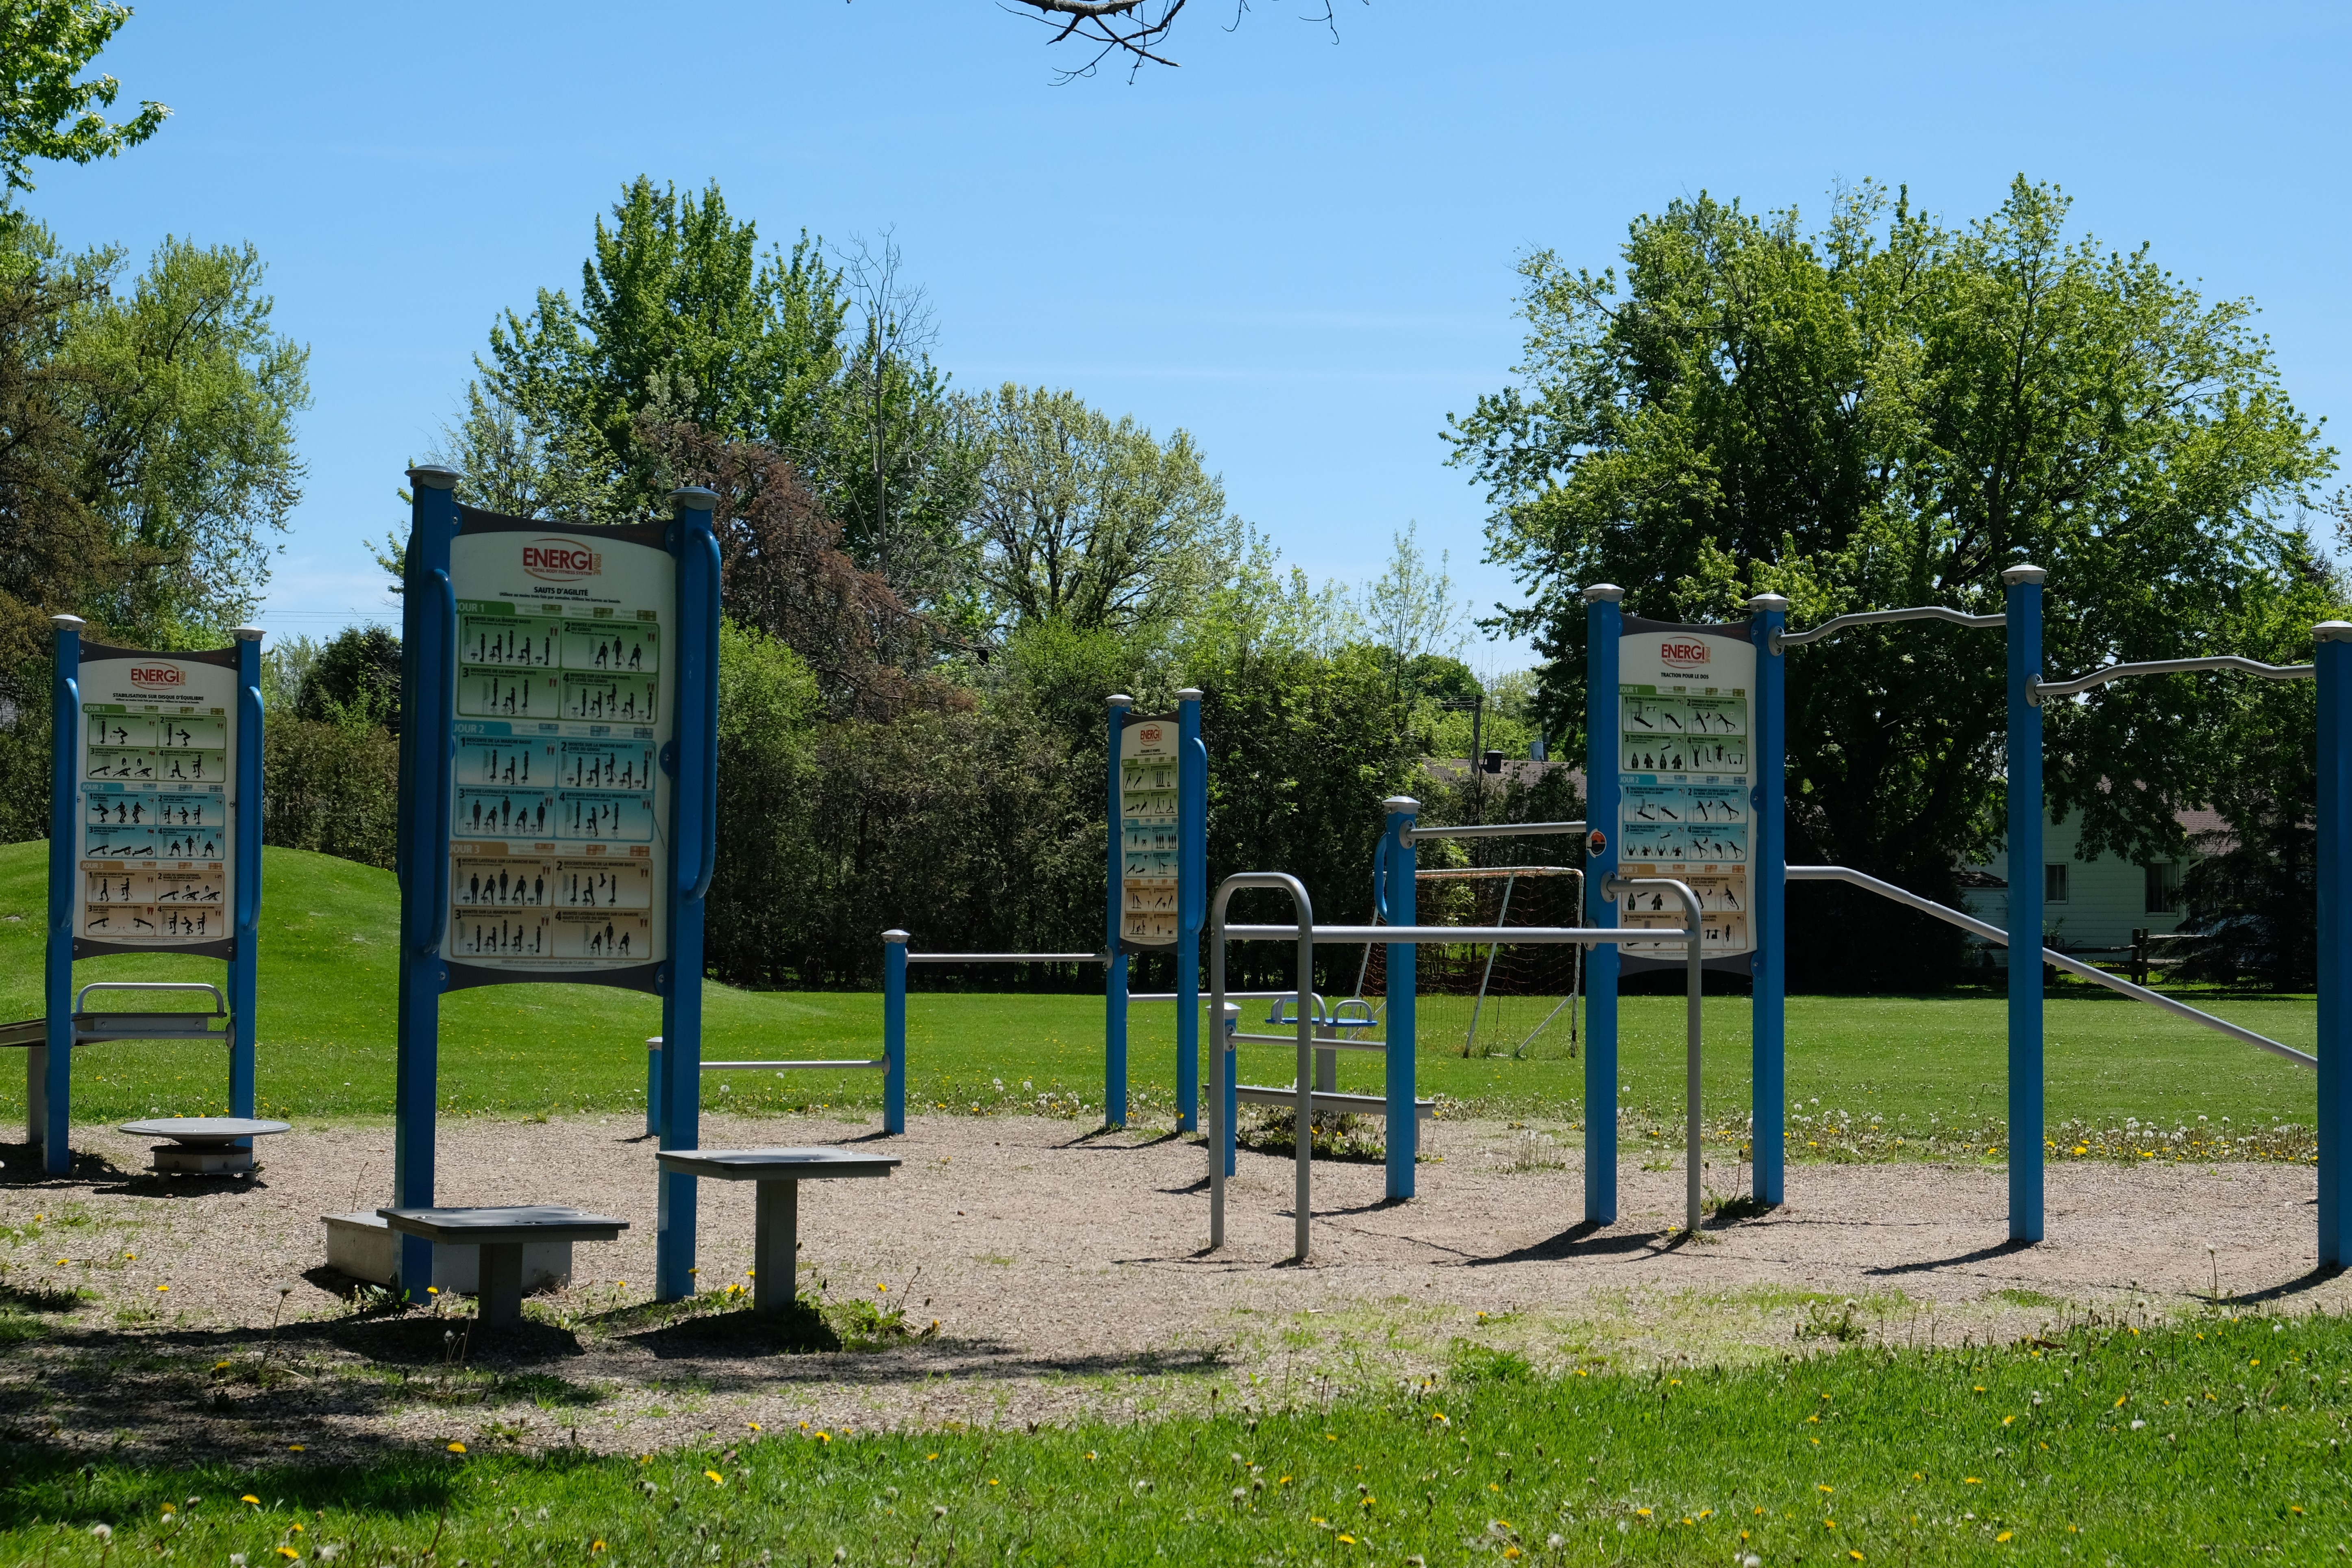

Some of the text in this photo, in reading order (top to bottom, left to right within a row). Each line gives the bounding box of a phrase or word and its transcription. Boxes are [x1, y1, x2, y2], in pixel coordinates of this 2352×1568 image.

[523, 548, 592, 570] ENERGI
[557, 587, 588, 596] D'AGILITÉ
[456, 602, 484, 612] JOUR 1
[464, 616, 468, 626] 1
[565, 622, 570, 631] 2
[1662, 644, 1704, 659] ENERGI
[131, 668, 179, 682] ENERGI
[463, 668, 468, 677] 3
[563, 673, 569, 682] 4
[454, 724, 484, 733] JOUR 2
[1140, 729, 1160, 739] ENERGI
[461, 737, 465, 747] 1
[561, 742, 566, 751] 2
[459, 789, 465, 798] 3
[559, 792, 565, 802] 4
[449, 844, 480, 854] JOUR 3
[457, 858, 461, 868] 1
[557, 861, 562, 870] 2
[455, 910, 461, 919] 3
[555, 911, 561, 920] 4
